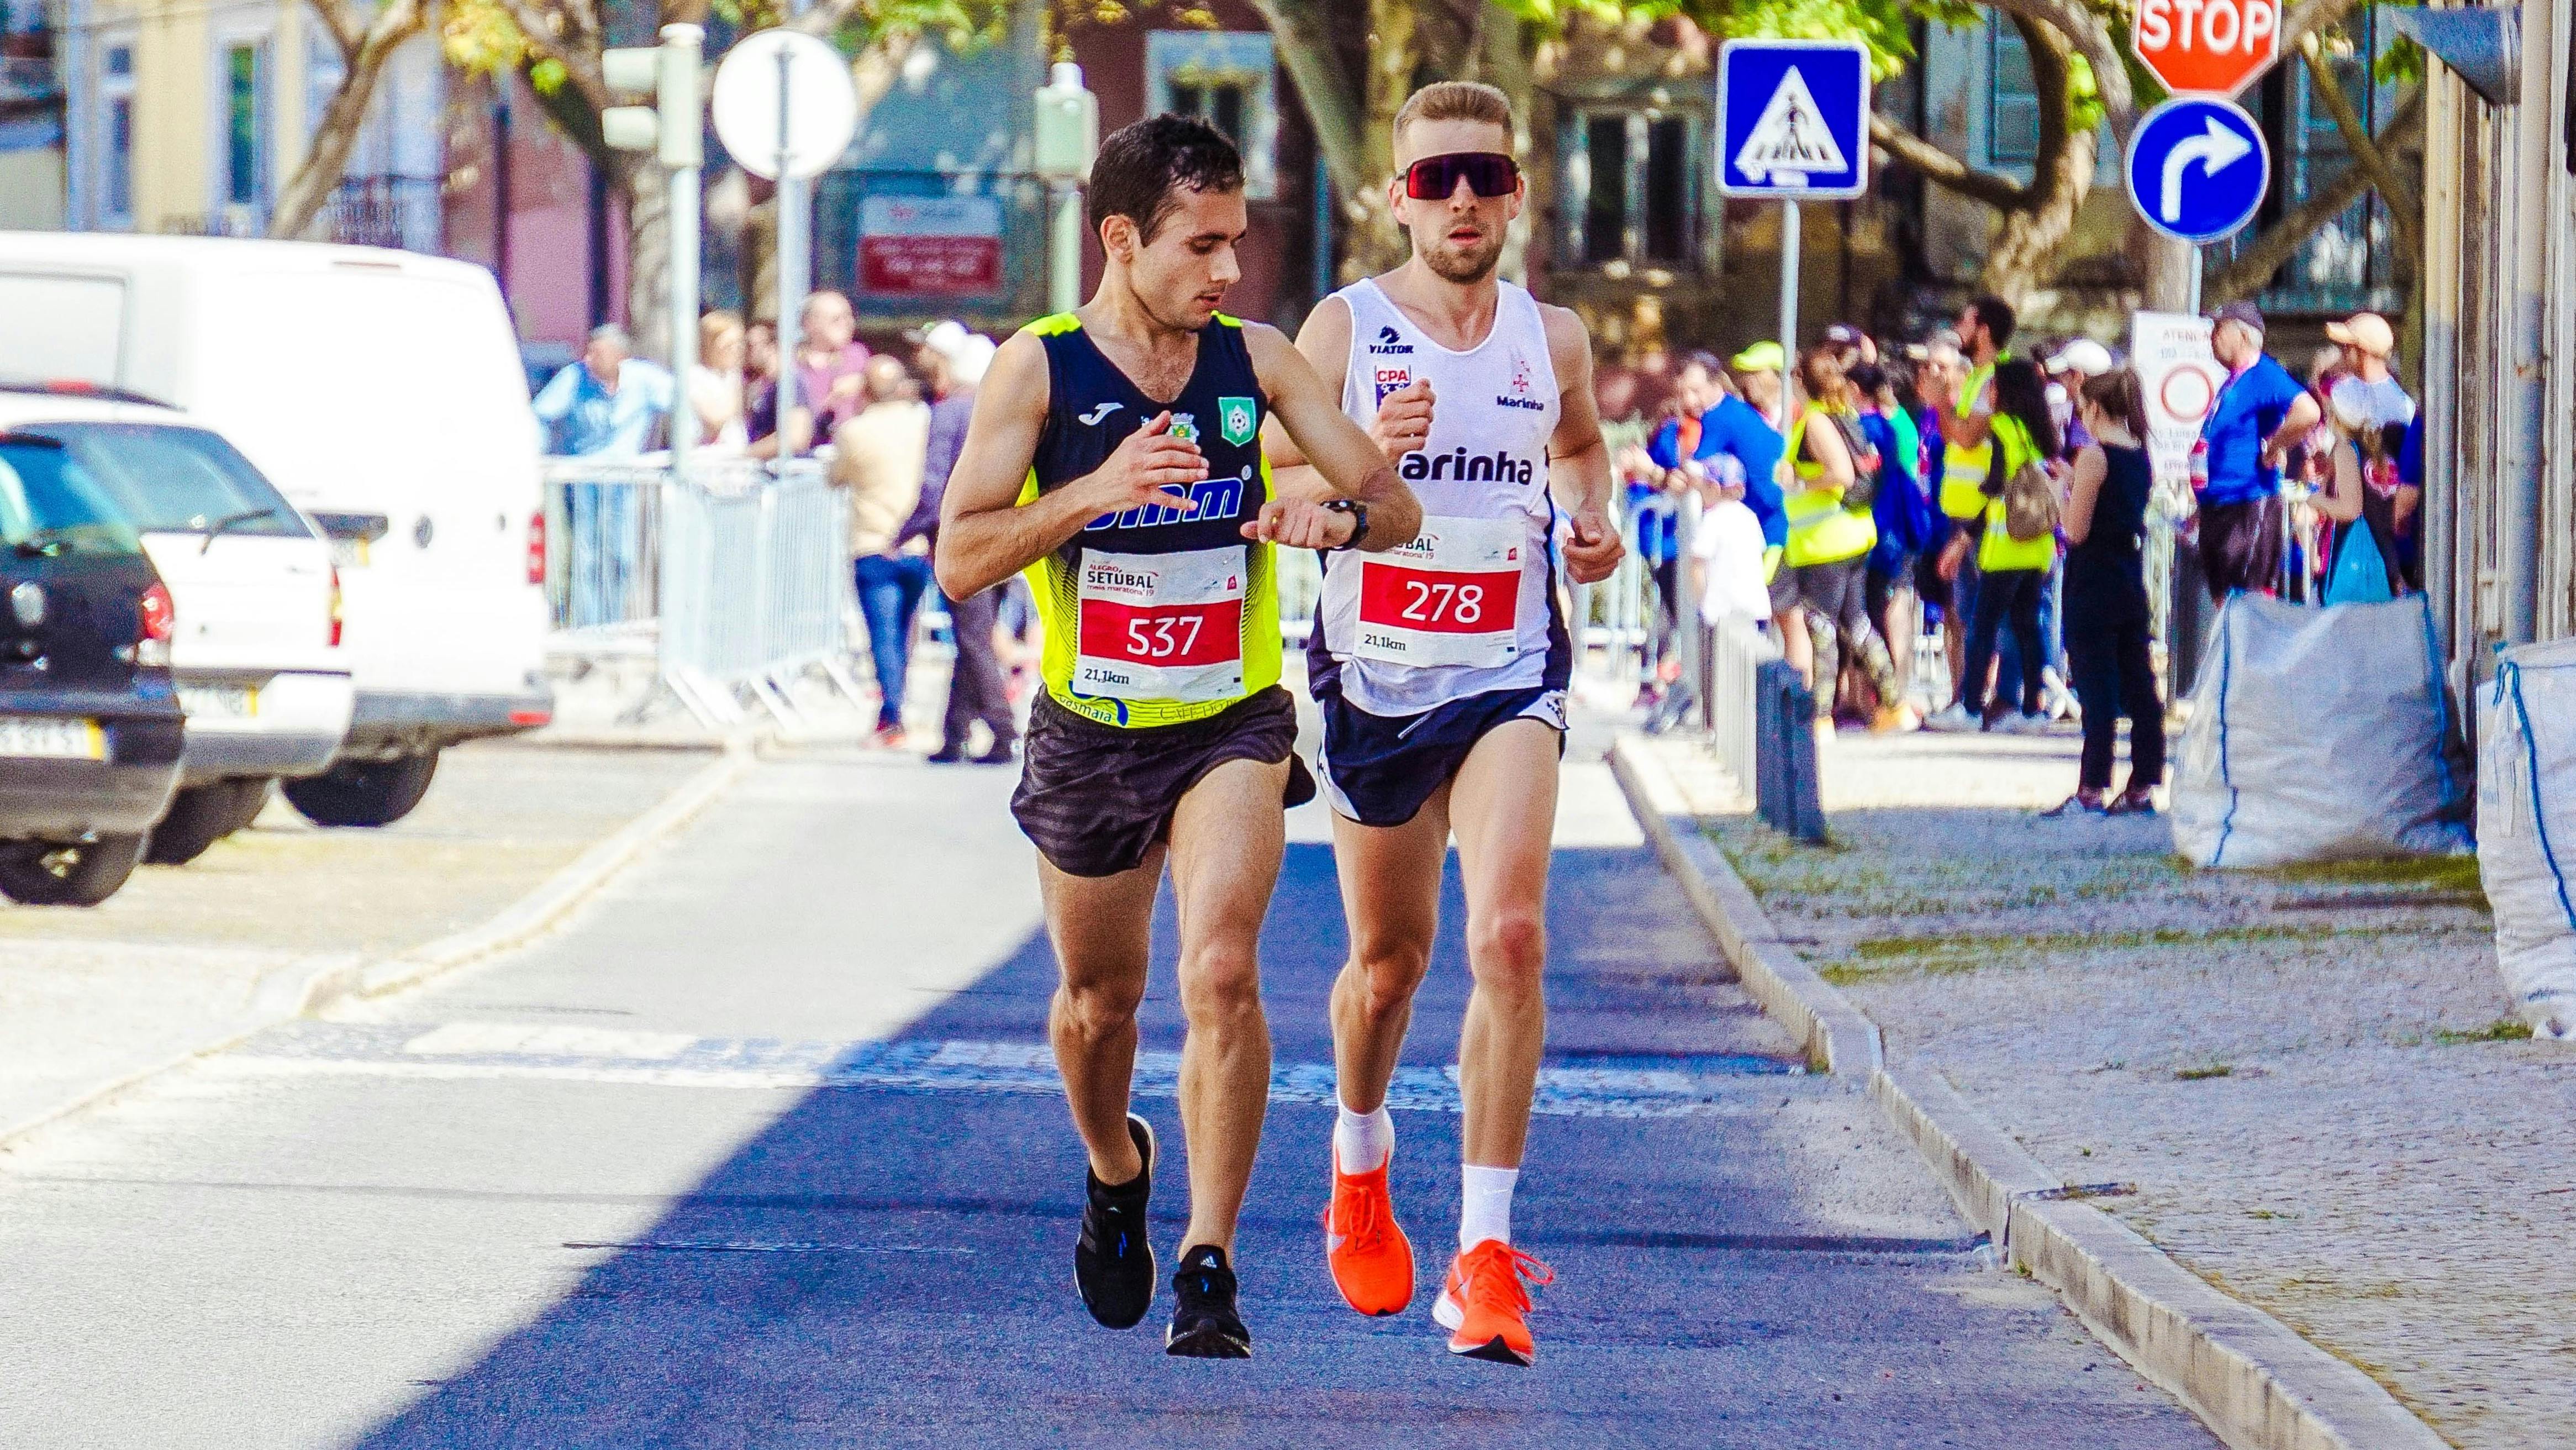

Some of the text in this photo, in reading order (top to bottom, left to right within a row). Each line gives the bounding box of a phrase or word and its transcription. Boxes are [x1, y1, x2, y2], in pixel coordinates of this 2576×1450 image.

[2140, 0, 2274, 54] STOP
[1369, 344, 1414, 354] VIATOR
[1378, 370, 1408, 382] CPA
[1497, 395, 1545, 411] Marinha
[1402, 446, 1533, 486] arinha
[1089, 564, 1119, 572] ALEGRO
[1088, 569, 1154, 589] SETÚBAL
[1402, 581, 1483, 623] 278
[1126, 616, 1203, 657] 537
[1364, 634, 1406, 651] 21,1km
[1084, 668, 1130, 685] 21,1km
